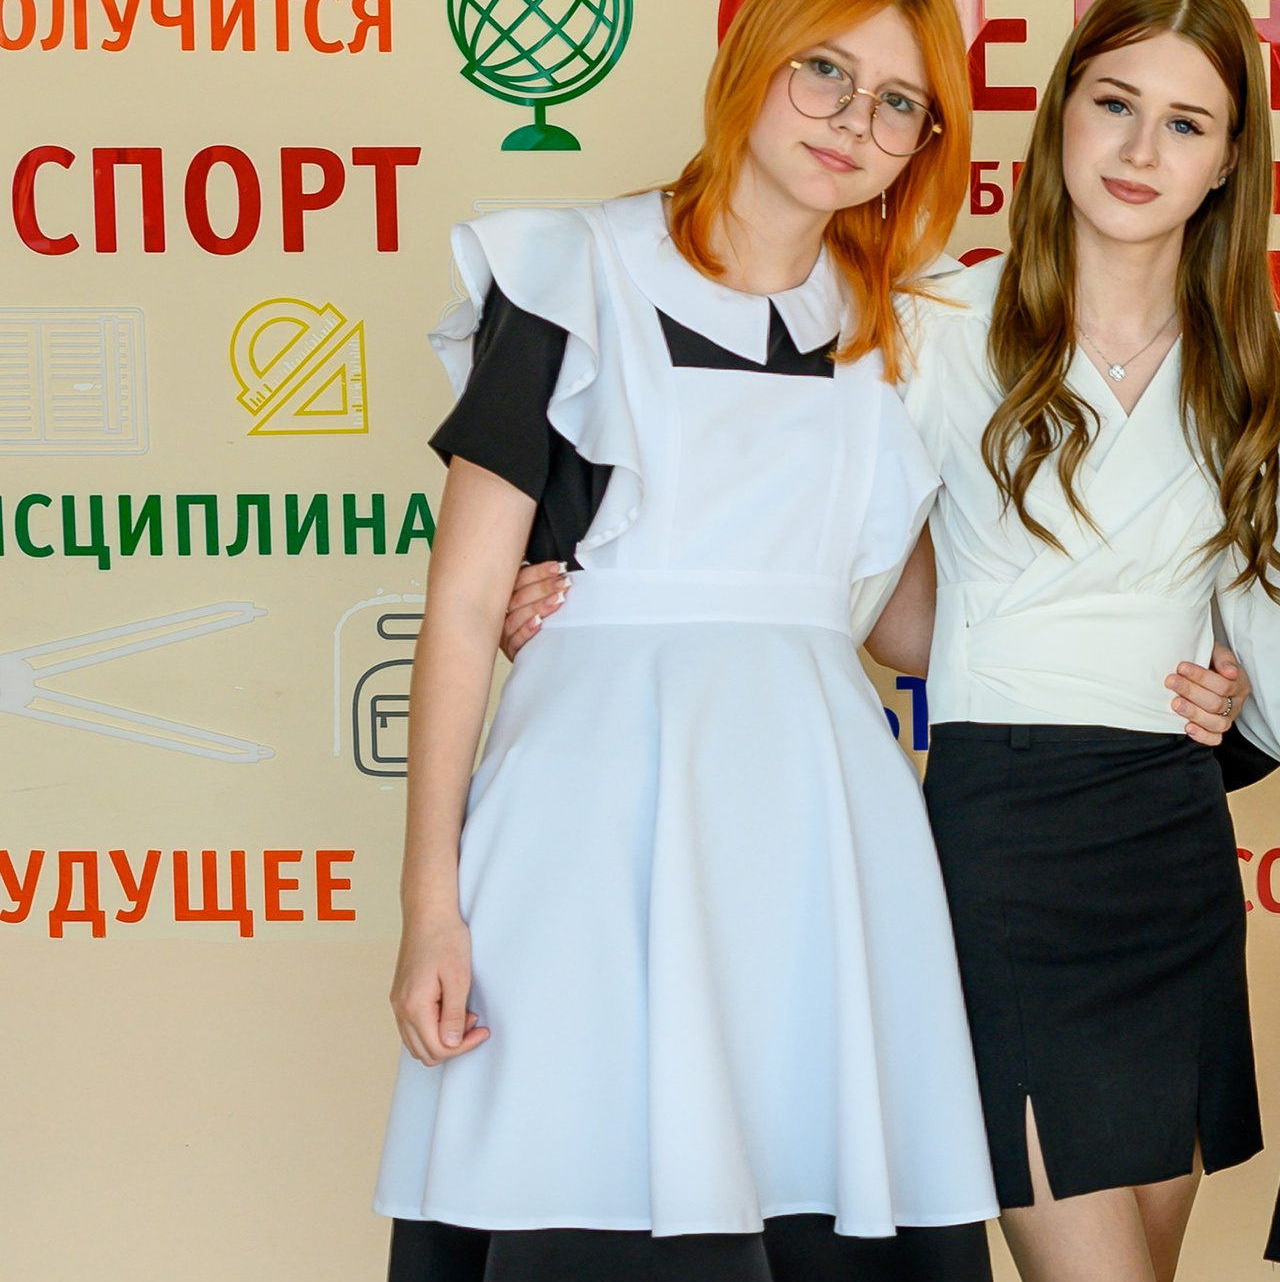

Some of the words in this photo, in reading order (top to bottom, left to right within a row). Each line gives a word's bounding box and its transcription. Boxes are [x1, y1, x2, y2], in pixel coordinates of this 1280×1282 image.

[11, 144, 423, 257] СПОРТ
[0, 492, 437, 571] СЦИПЛИНА
[0, 848, 357, 939] УДУЩЕЕ
